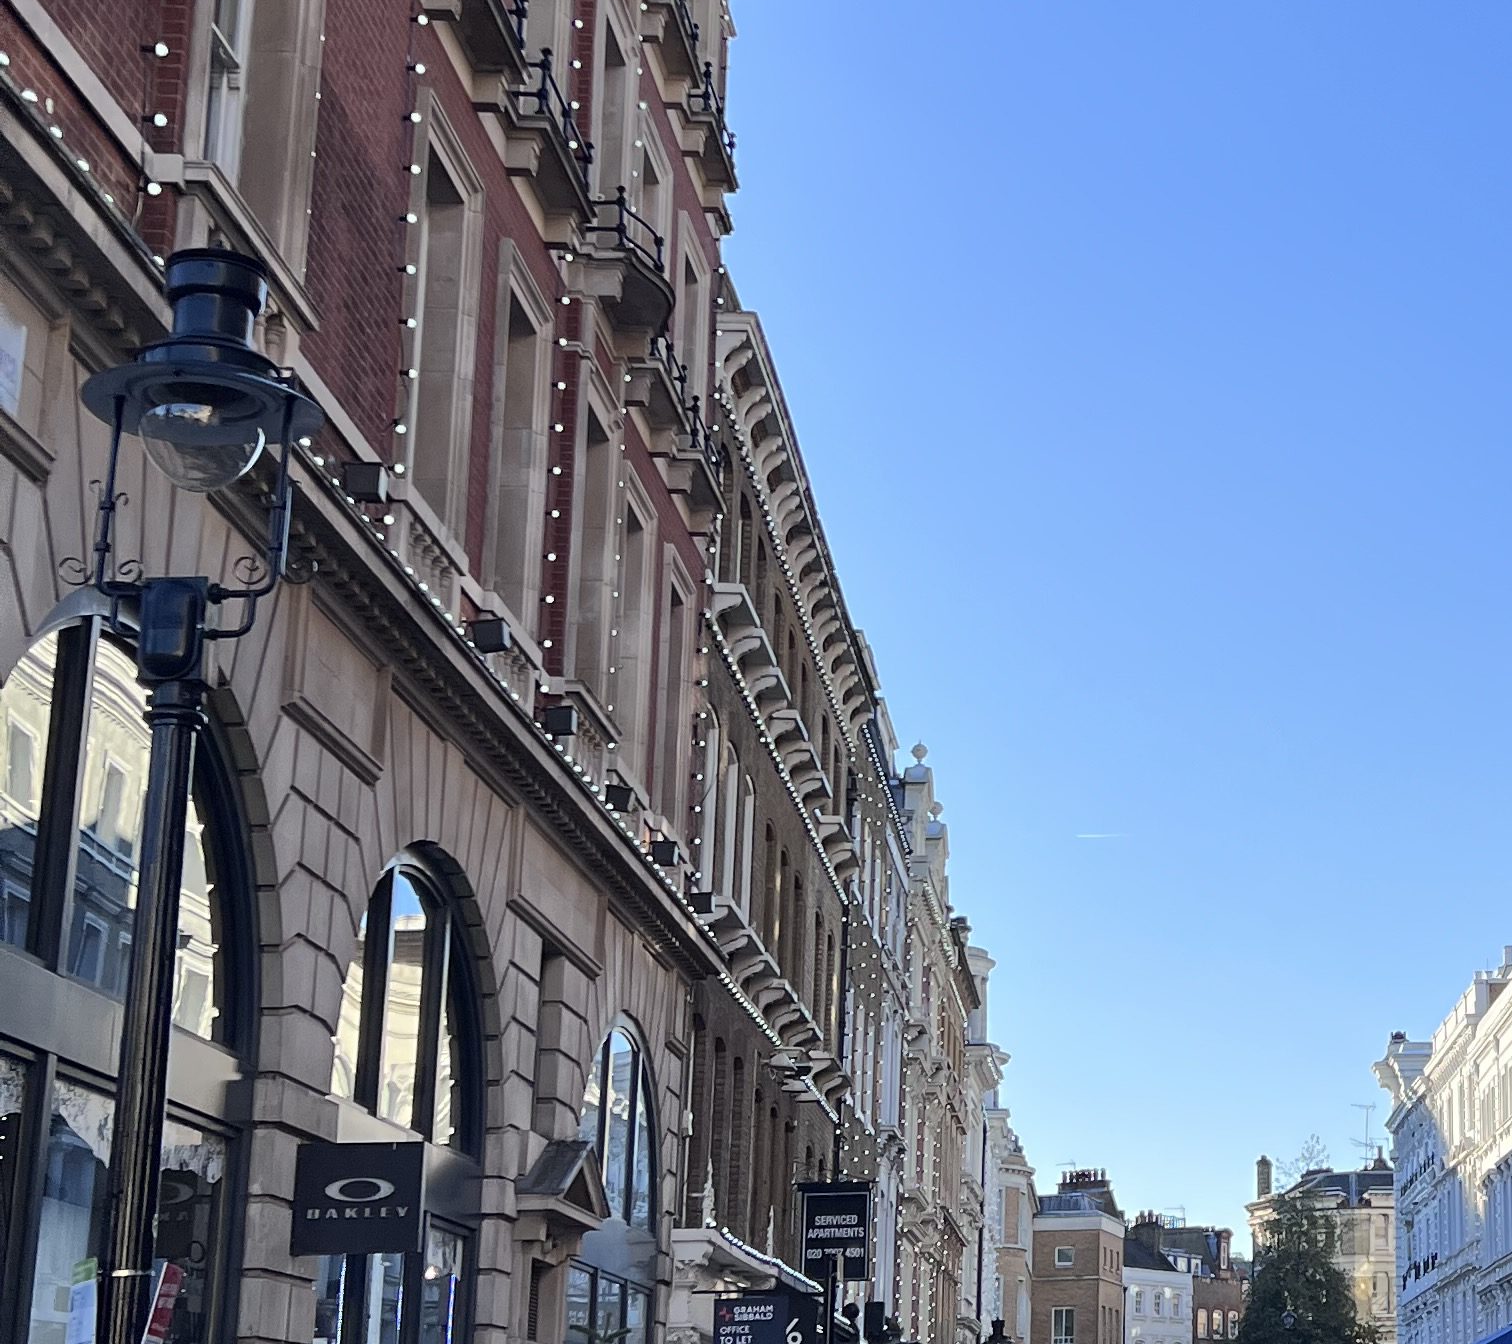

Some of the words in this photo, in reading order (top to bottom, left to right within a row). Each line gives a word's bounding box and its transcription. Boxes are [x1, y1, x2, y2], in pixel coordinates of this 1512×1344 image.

[306, 1206, 409, 1220] OAKLEY
[814, 1215, 859, 1227] SERVICED
[807, 1227, 865, 1239] APARTMENTS
[806, 1248, 823, 1260] 020
[845, 1247, 865, 1258] 4501
[733, 1305, 774, 1314] GRAHAM
[733, 1313, 774, 1322] SIBBALD
[719, 1325, 750, 1335] OFFICE
[735, 1335, 752, 1344] LET
